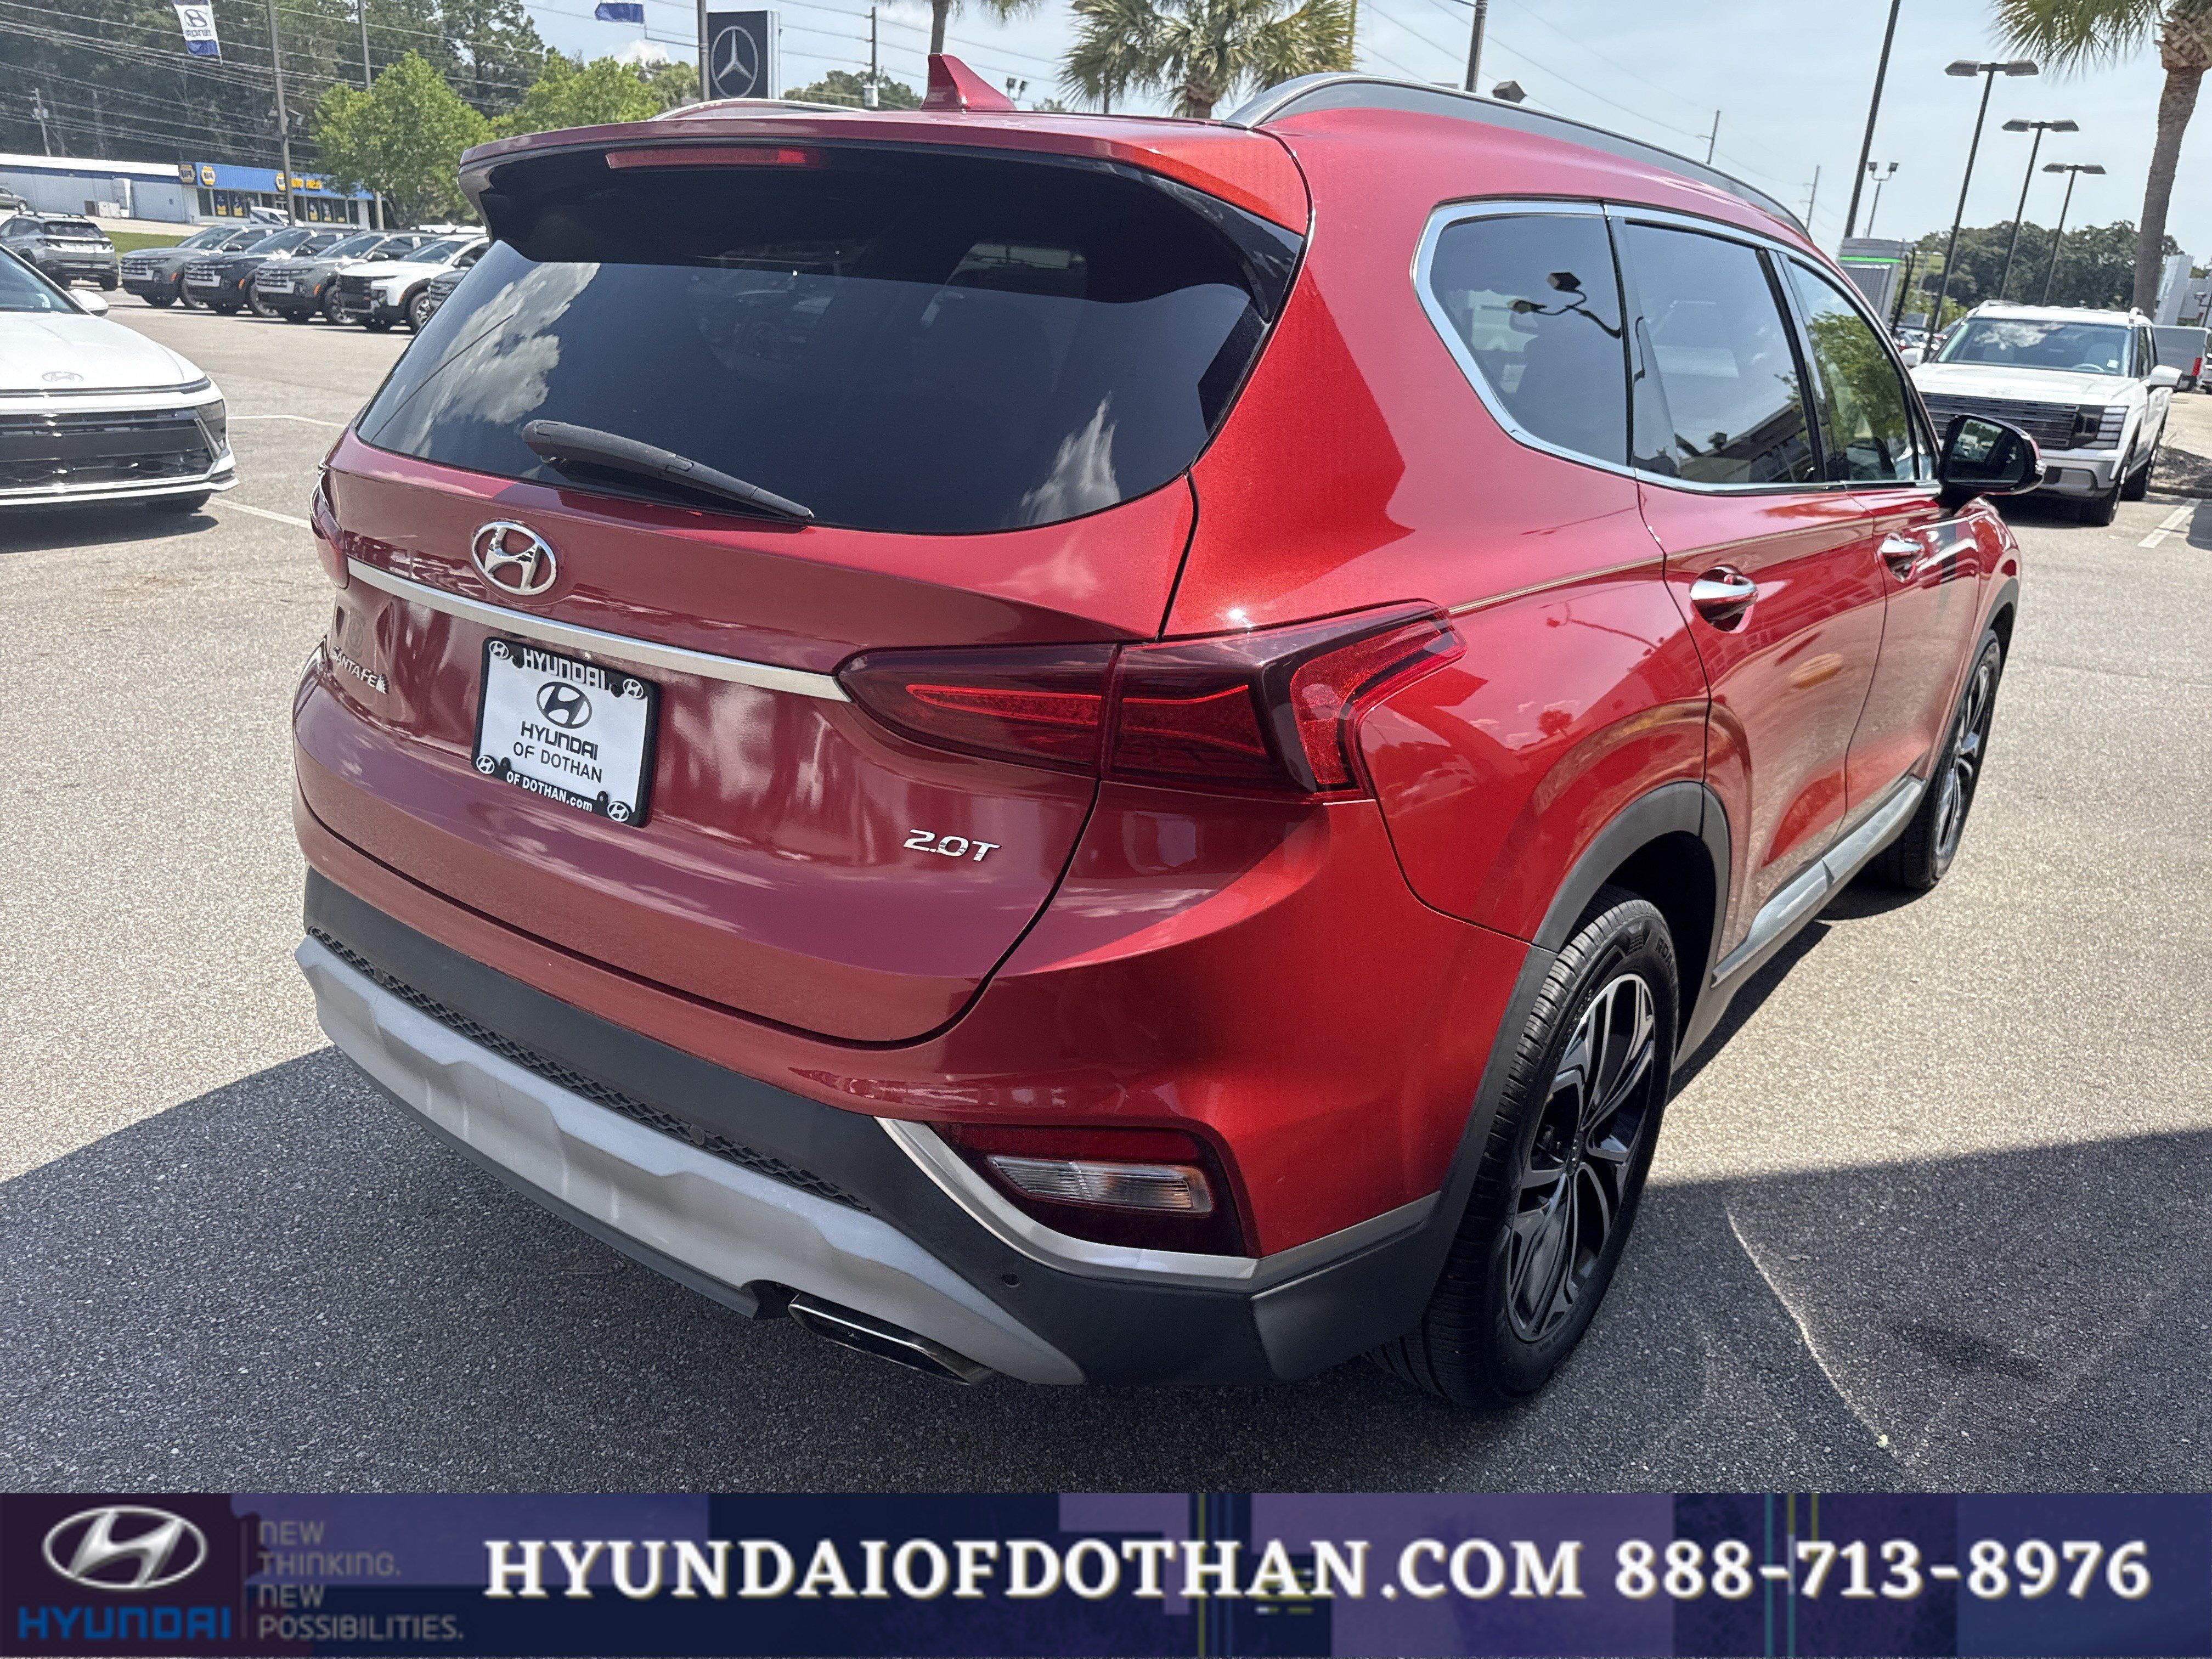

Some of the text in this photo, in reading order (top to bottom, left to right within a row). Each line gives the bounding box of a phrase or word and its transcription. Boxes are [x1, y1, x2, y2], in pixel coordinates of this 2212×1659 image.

[523, 648, 606, 690] HYUNDAI
[521, 720, 599, 761] HYUNDAI
[513, 742, 603, 783] OF DOTHAN
[506, 771, 594, 812] OF DOTHAN.com
[903, 829, 1001, 862] 2.0T
